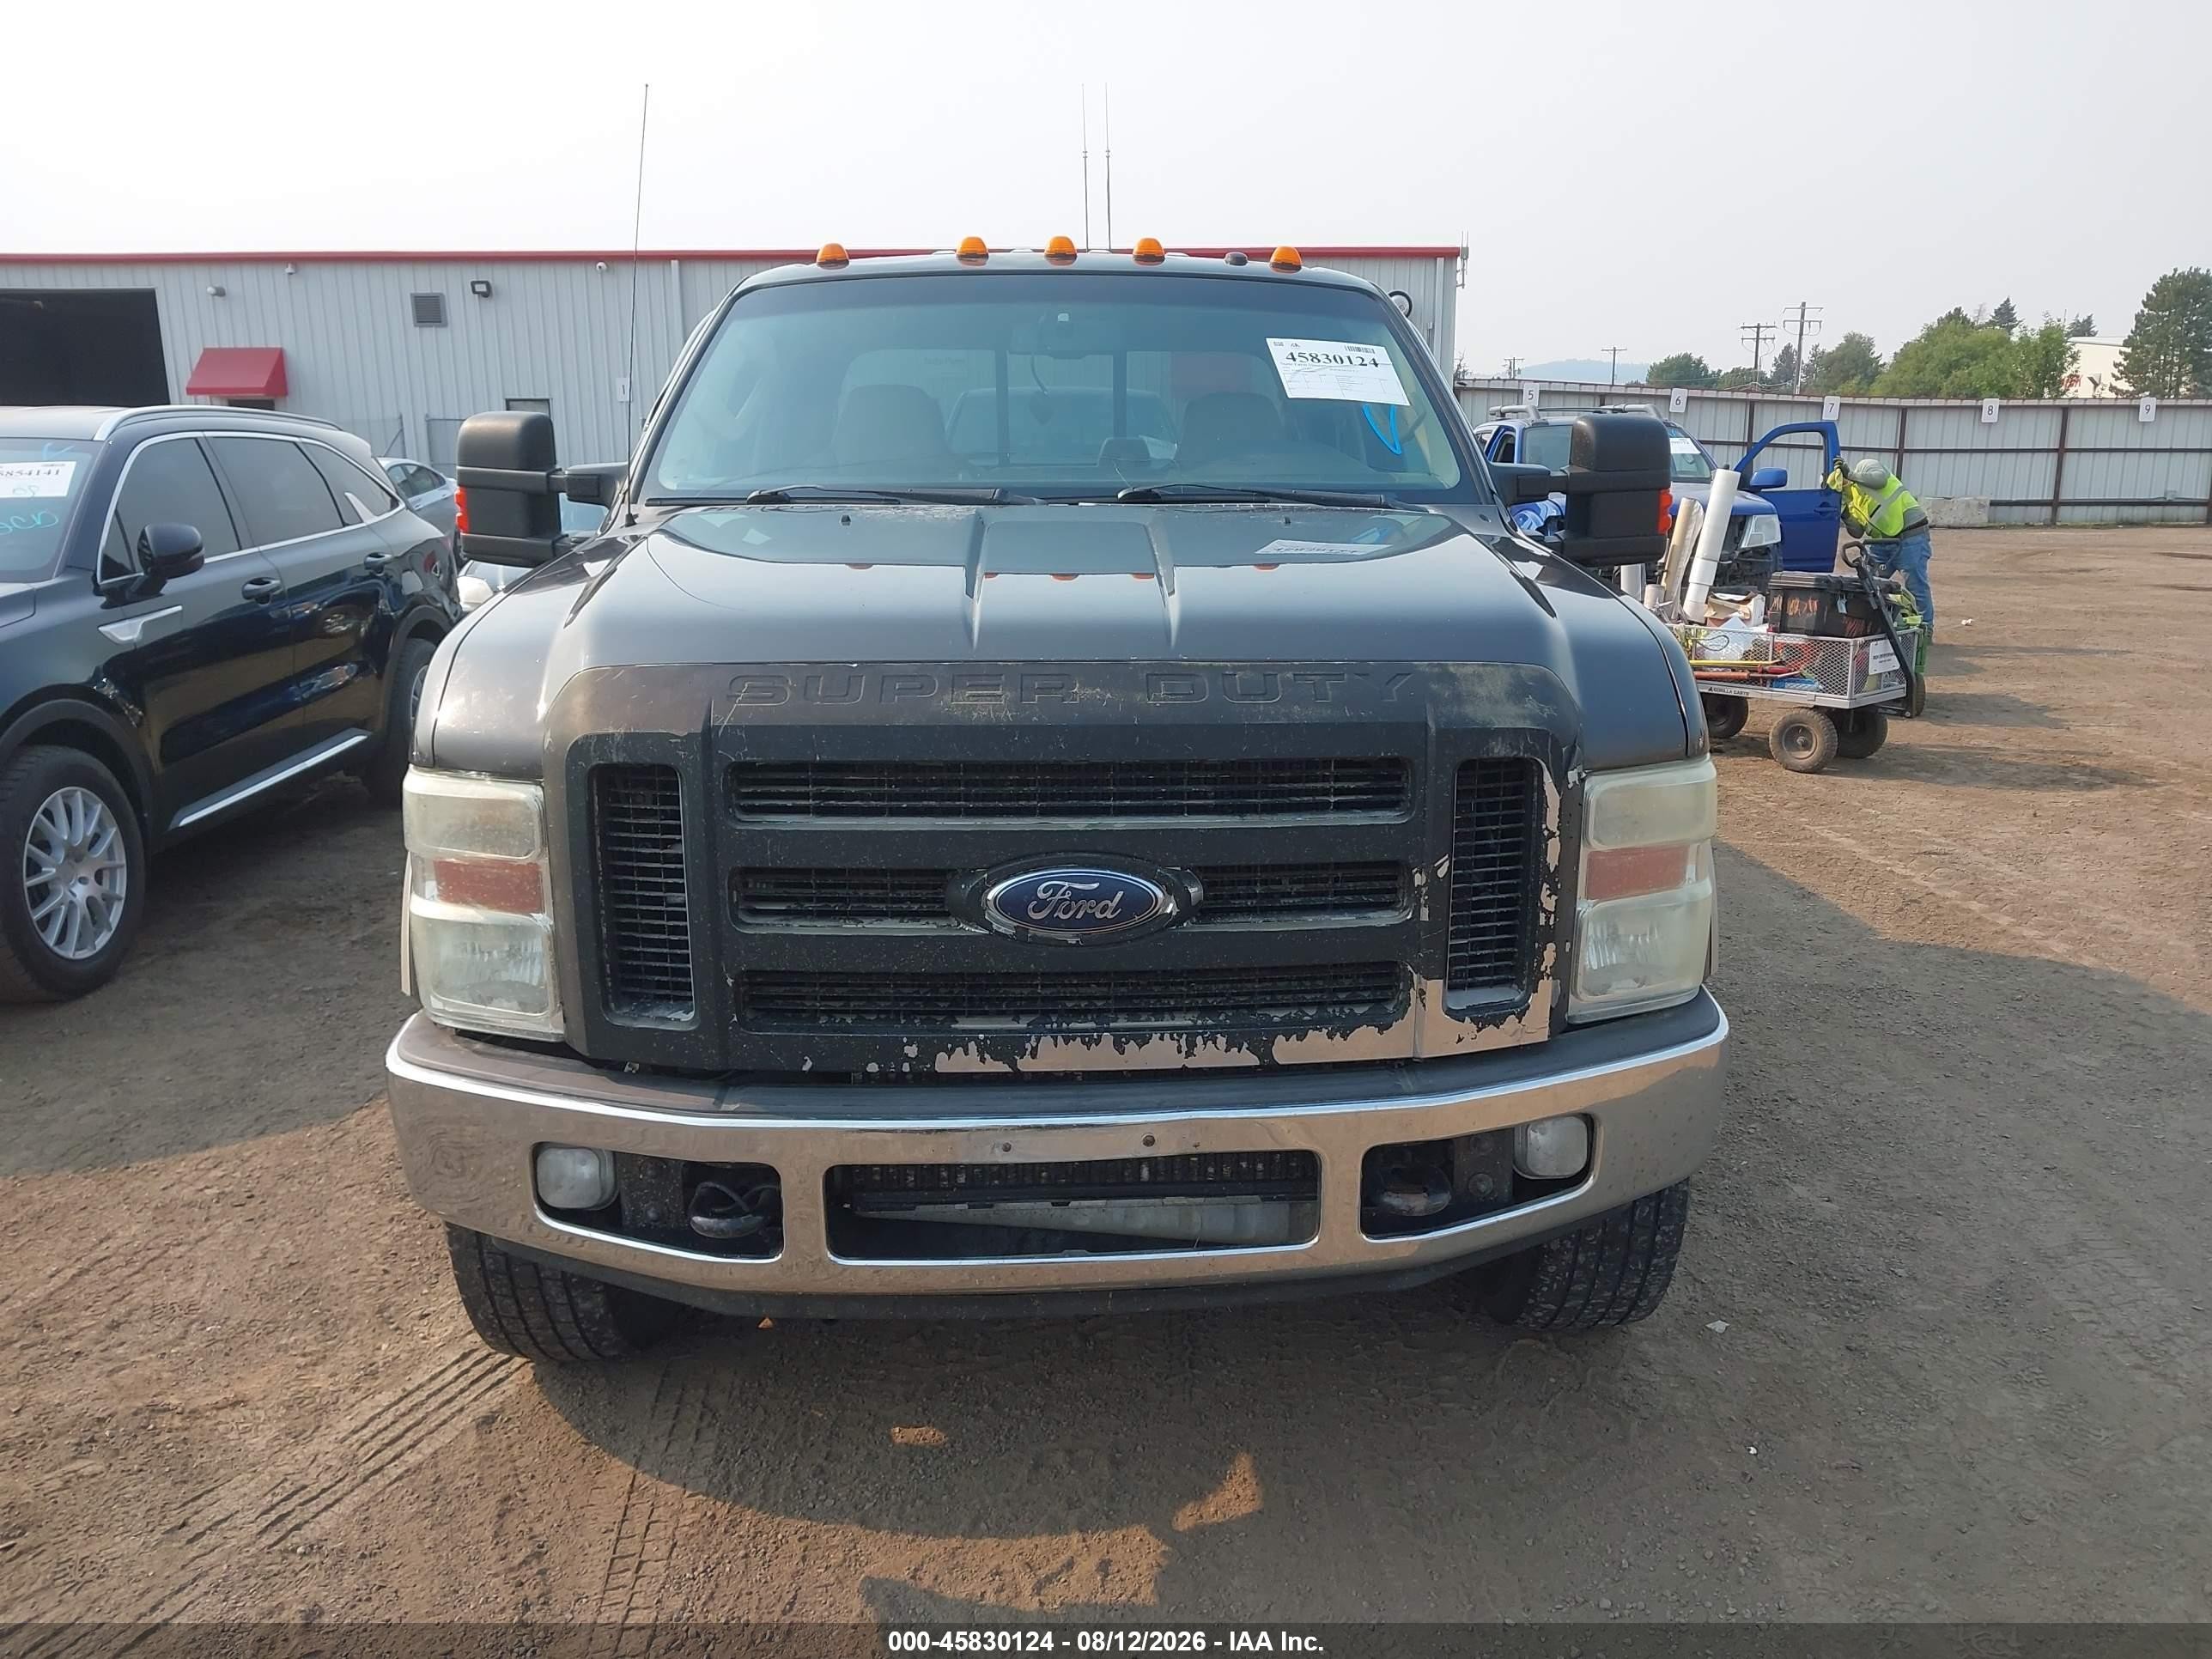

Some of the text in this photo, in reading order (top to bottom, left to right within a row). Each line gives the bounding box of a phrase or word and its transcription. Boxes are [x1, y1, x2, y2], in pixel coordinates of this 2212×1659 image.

[1285, 351, 1379, 368] 45830124
[1528, 390, 1534, 400] 5
[1675, 395, 1681, 406] 6
[1828, 403, 1835, 413] 7
[1987, 404, 1994, 416] 8
[2144, 404, 2151, 414] 9
[726, 672, 1413, 706] SUPER DUTY
[1027, 880, 1124, 920] Ford
